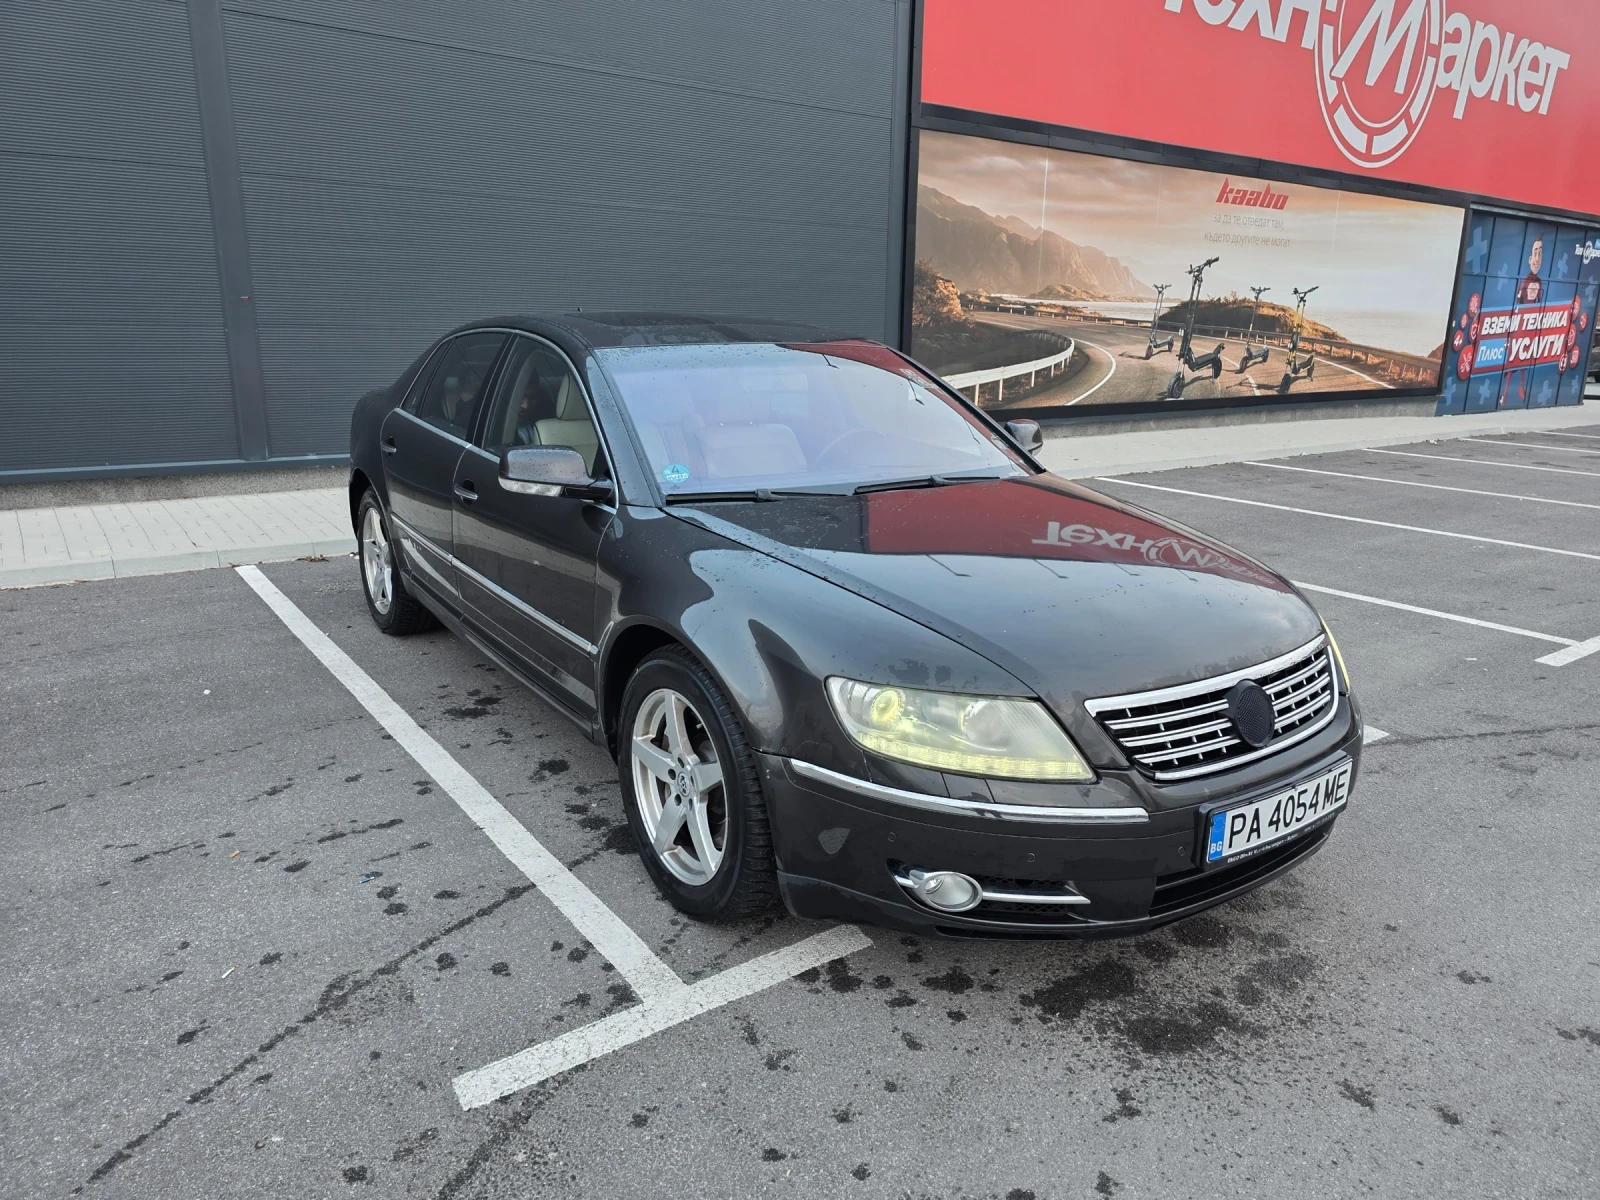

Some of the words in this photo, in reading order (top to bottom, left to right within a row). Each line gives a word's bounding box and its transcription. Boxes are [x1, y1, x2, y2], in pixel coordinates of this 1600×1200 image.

[1216, 177, 1289, 210] kaabo
[1213, 213, 1221, 223] за
[1222, 214, 1231, 226] да
[1233, 215, 1241, 226] те
[1242, 216, 1270, 229] отведат
[1204, 232, 1231, 244] където
[1231, 233, 1260, 247] другите
[1261, 237, 1270, 247] не
[1271, 238, 1291, 248] могат
[1481, 314, 1521, 336] ВЗЕМИ
[1522, 310, 1569, 332] ТЕХНИКА
[1509, 333, 1566, 362] УСЛУГИ
[1228, 807, 1261, 849] PA
[1268, 782, 1320, 833] 4054
[1322, 768, 1348, 811] ME
[1210, 840, 1223, 854] BG
